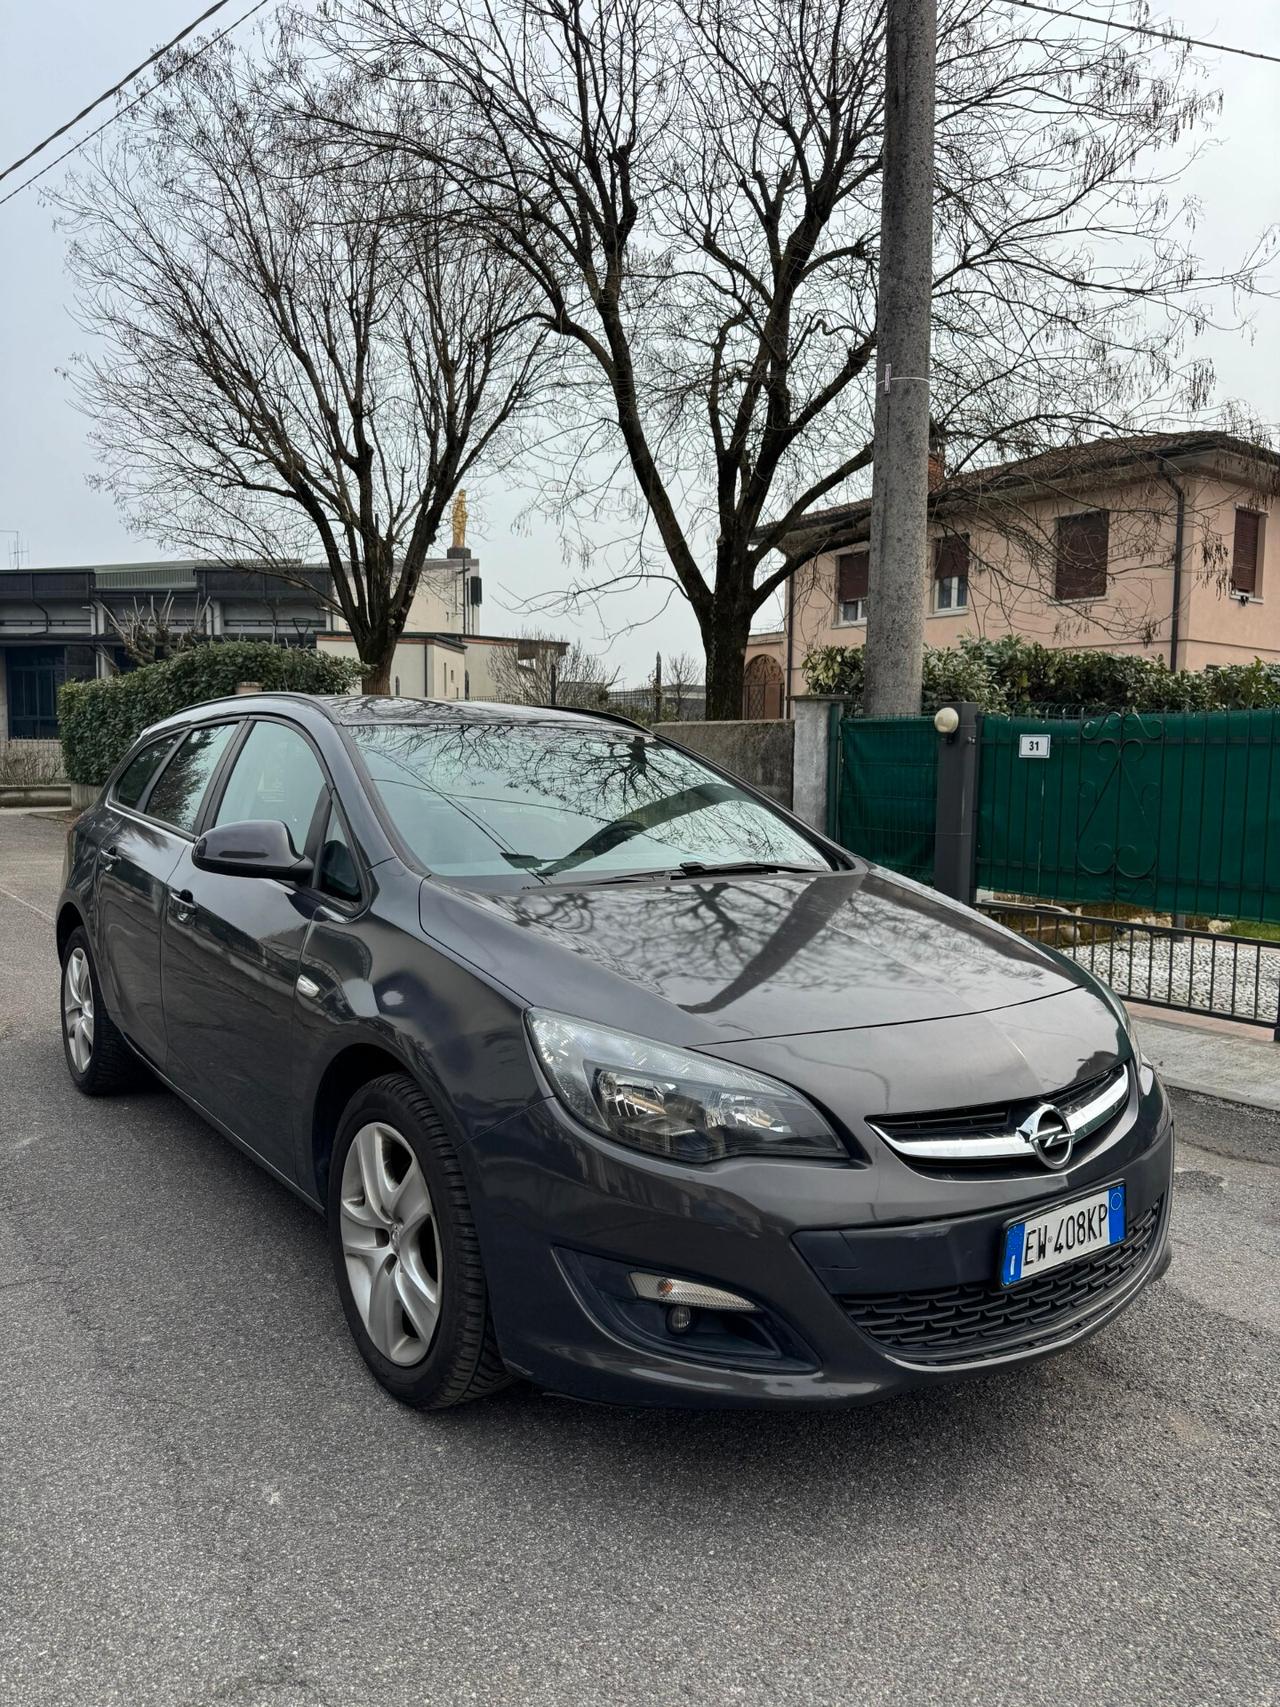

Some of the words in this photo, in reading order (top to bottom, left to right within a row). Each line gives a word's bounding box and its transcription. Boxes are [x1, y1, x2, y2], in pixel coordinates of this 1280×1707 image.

[1029, 740, 1039, 751] 31
[1024, 1224, 1048, 1266] EW
[1054, 1203, 1107, 1254] 408KP
